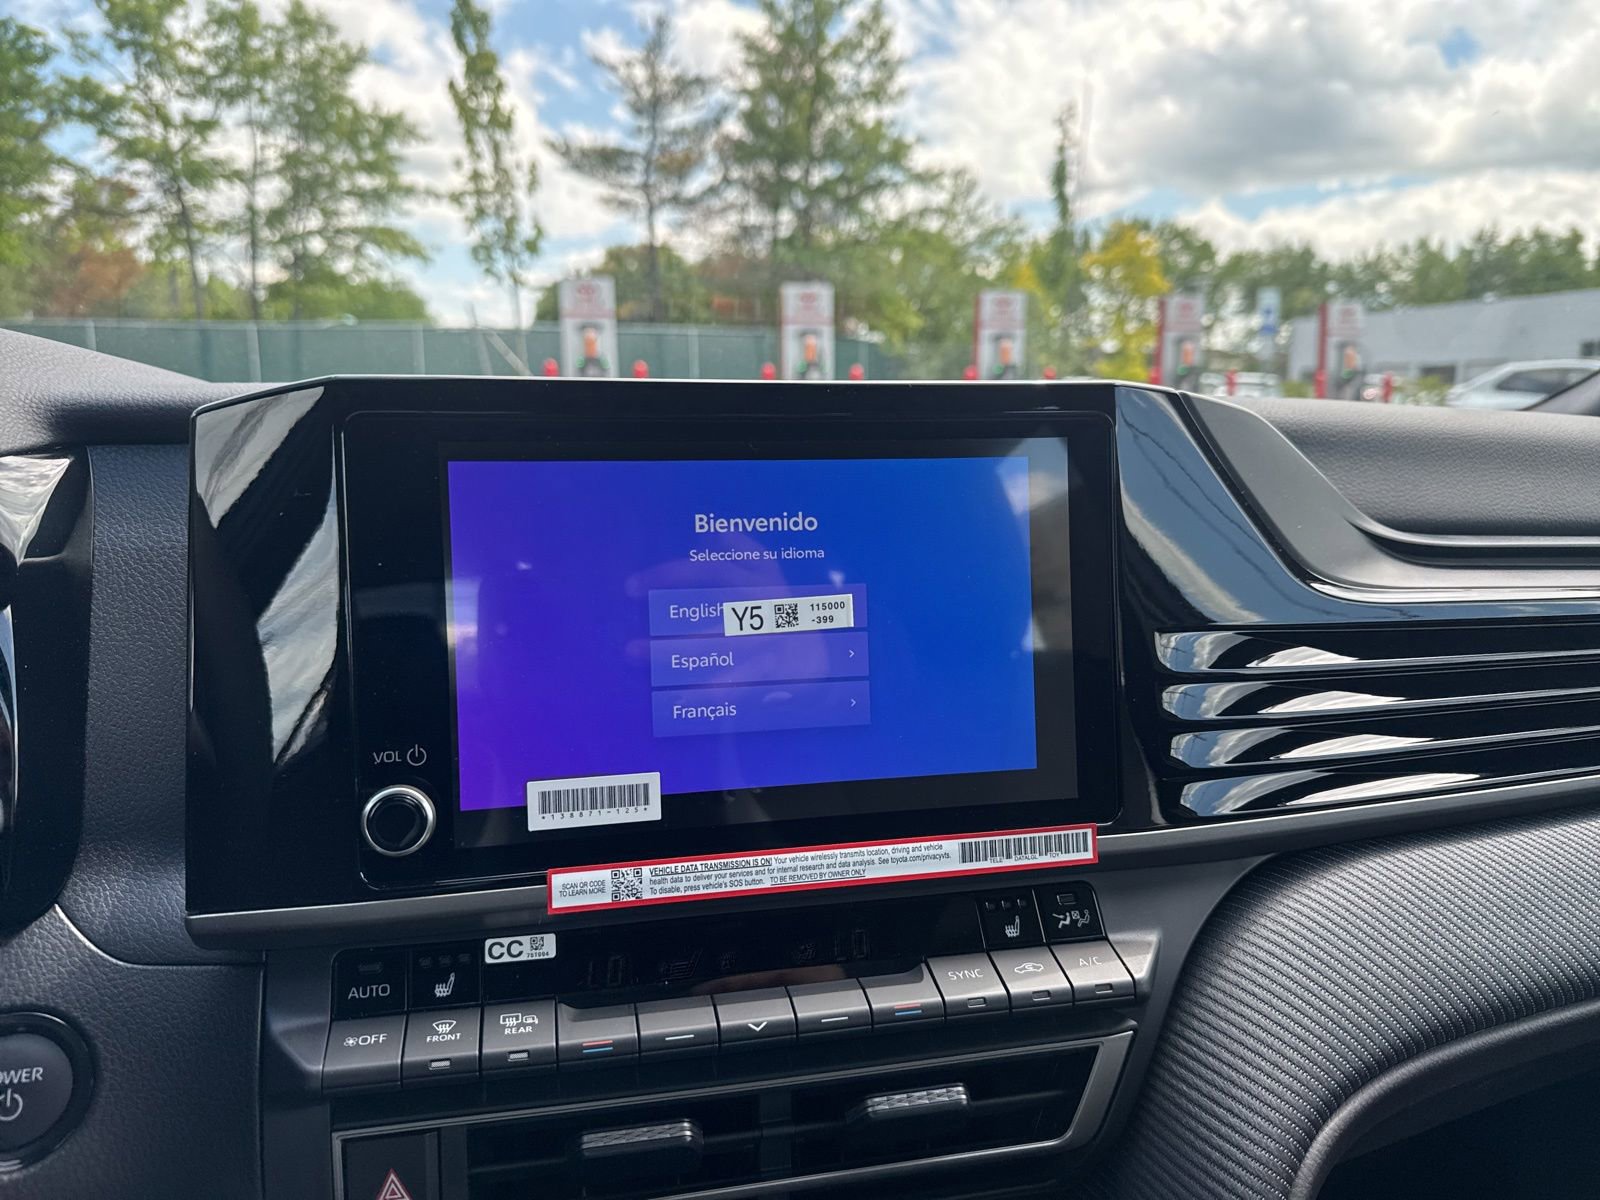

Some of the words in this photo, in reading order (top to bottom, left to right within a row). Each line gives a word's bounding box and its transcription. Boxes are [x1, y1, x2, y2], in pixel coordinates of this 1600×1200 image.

[694, 511, 818, 533] Bienvenido
[689, 549, 760, 562] Seleccione
[763, 550, 777, 560] su
[781, 547, 825, 559] idioma
[669, 603, 724, 622] English
[809, 601, 846, 611] 115000
[731, 605, 764, 631] Y5
[811, 615, 834, 625] -399
[671, 652, 735, 670] Español
[673, 702, 737, 721] Français
[373, 751, 402, 765] VOL
[649, 865, 679, 875] VEHICLE
[680, 863, 698, 873] DATA
[700, 859, 751, 871] TRANSMISSION
[760, 857, 772, 865] ON!
[773, 856, 788, 865] Your
[789, 855, 809, 864] vehicle
[810, 851, 838, 862] wirelessly
[839, 850, 865, 859] transmits
[866, 847, 890, 857] location,
[891, 845, 910, 855] driving
[911, 844, 922, 852] and
[923, 843, 943, 851] vehicle
[649, 877, 668, 886] health
[669, 876, 683, 884] data
[692, 873, 713, 882] deliver
[714, 872, 728, 880] your
[728, 869, 753, 878] services
[754, 867, 766, 875] and
[767, 867, 775, 875] for
[776, 865, 799, 873] internal
[799, 862, 825, 871] research
[825, 861, 837, 869] and
[837, 860, 851, 868] data
[878, 857, 890, 865] See
[779, 875, 787, 883] BE
[788, 872, 818, 881] REMOVED
[827, 869, 850, 878] OWNER
[850, 868, 866, 876] ONLY
[561, 882, 578, 890] SCAN
[588, 879, 606, 888] CODE
[649, 887, 658, 895] To
[658, 885, 683, 895] disable,
[683, 884, 700, 893] press
[701, 880, 728, 890] vehicle's
[729, 879, 744, 888] SOS
[568, 888, 587, 897] LEARN
[487, 940, 524, 960] CC
[1078, 957, 1102, 967] A/C
[948, 968, 984, 981] SYNC
[348, 983, 391, 999] AUTO
[426, 1032, 461, 1043] FRONT
[504, 1025, 533, 1035] REAR
[358, 1033, 388, 1046] OFF
